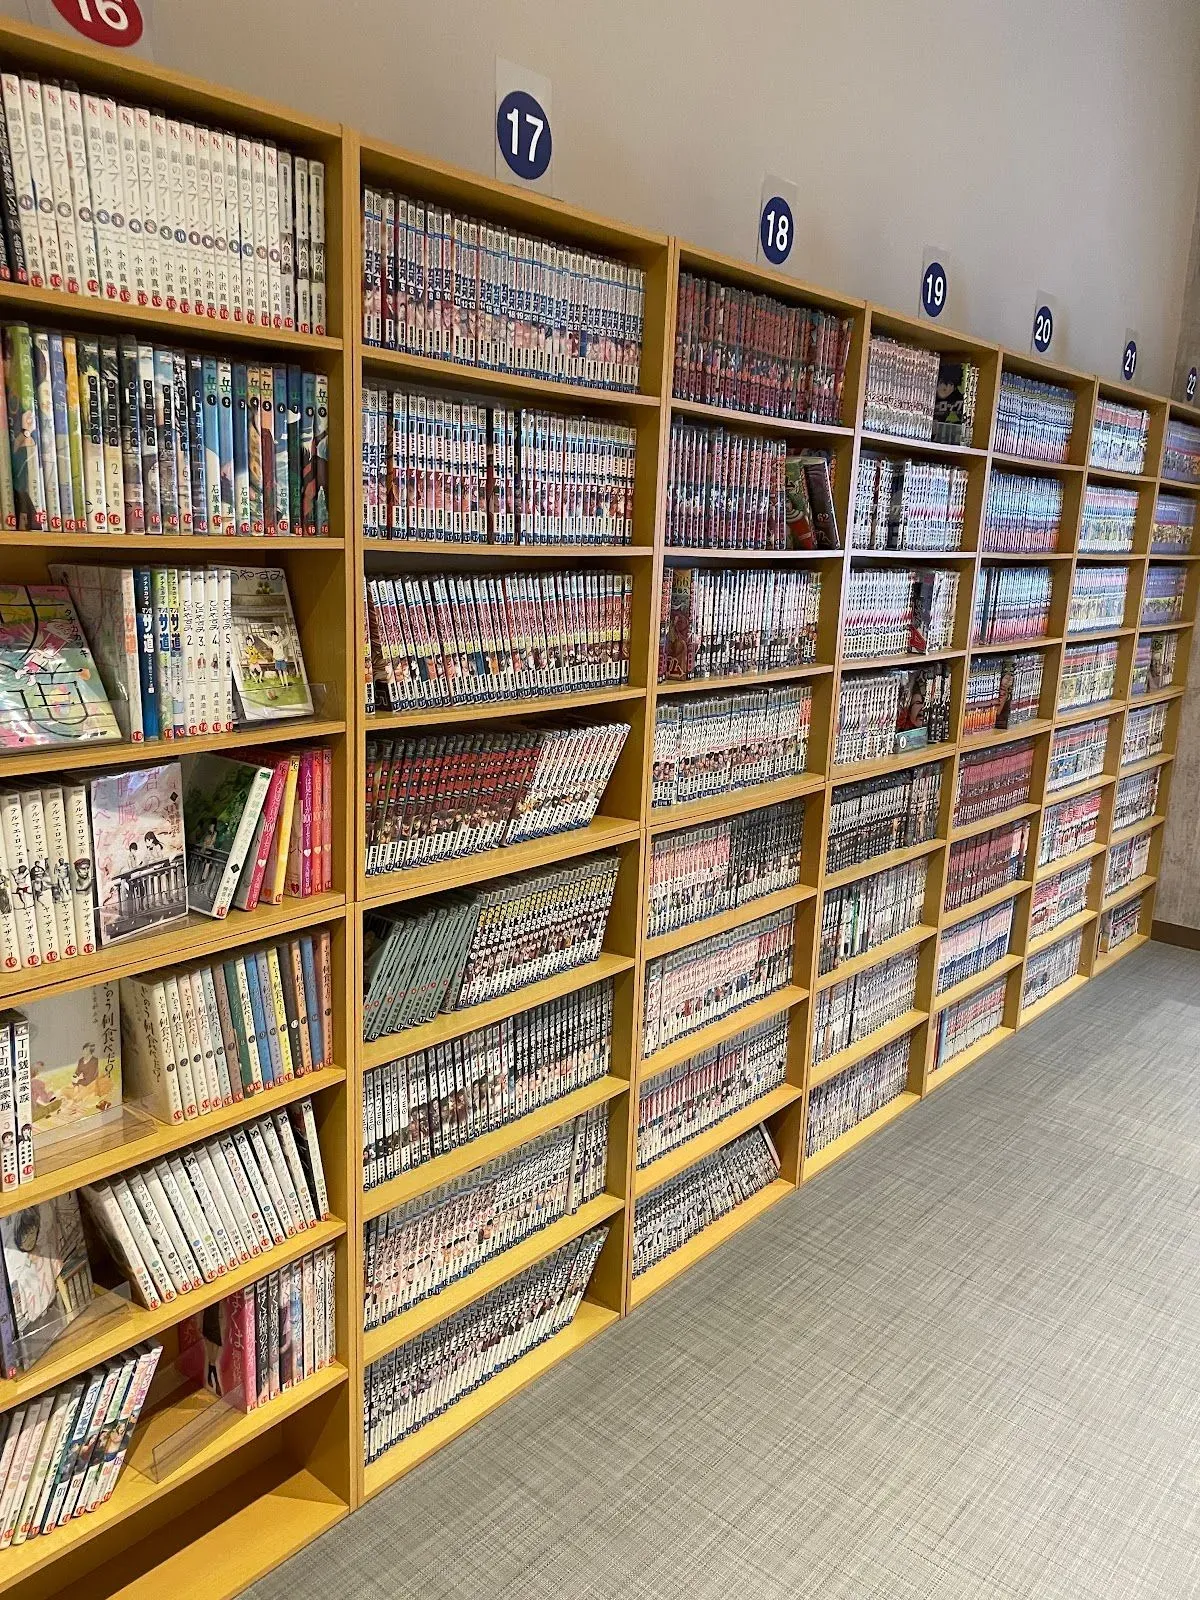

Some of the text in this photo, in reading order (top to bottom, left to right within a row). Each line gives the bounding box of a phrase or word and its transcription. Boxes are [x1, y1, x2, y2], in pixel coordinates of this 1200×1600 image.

[78, 0, 128, 30] 16
[507, 108, 543, 162] 17
[767, 210, 788, 251] 18
[926, 274, 944, 306] 19
[1035, 315, 1050, 343] 20
[1125, 349, 1136, 373] 21
[219, 377, 231, 393] 岳
[1186, 373, 1197, 395] 22
[111, 463, 118, 475] 2
[65, 608, 88, 658] タナカカツキ
[143, 614, 155, 653] サ道
[159, 614, 170, 652] サ道
[170, 613, 181, 651] サ道
[3, 914, 13, 957] ヤマザキマリ
[25, 911, 35, 954] ヤマザキマリ
[44, 906, 53, 949] ヤマザキマリ
[63, 903, 72, 945] ヤマザキマリ
[56, 1487, 66, 1497] 01
[72, 1479, 82, 1488] 02
